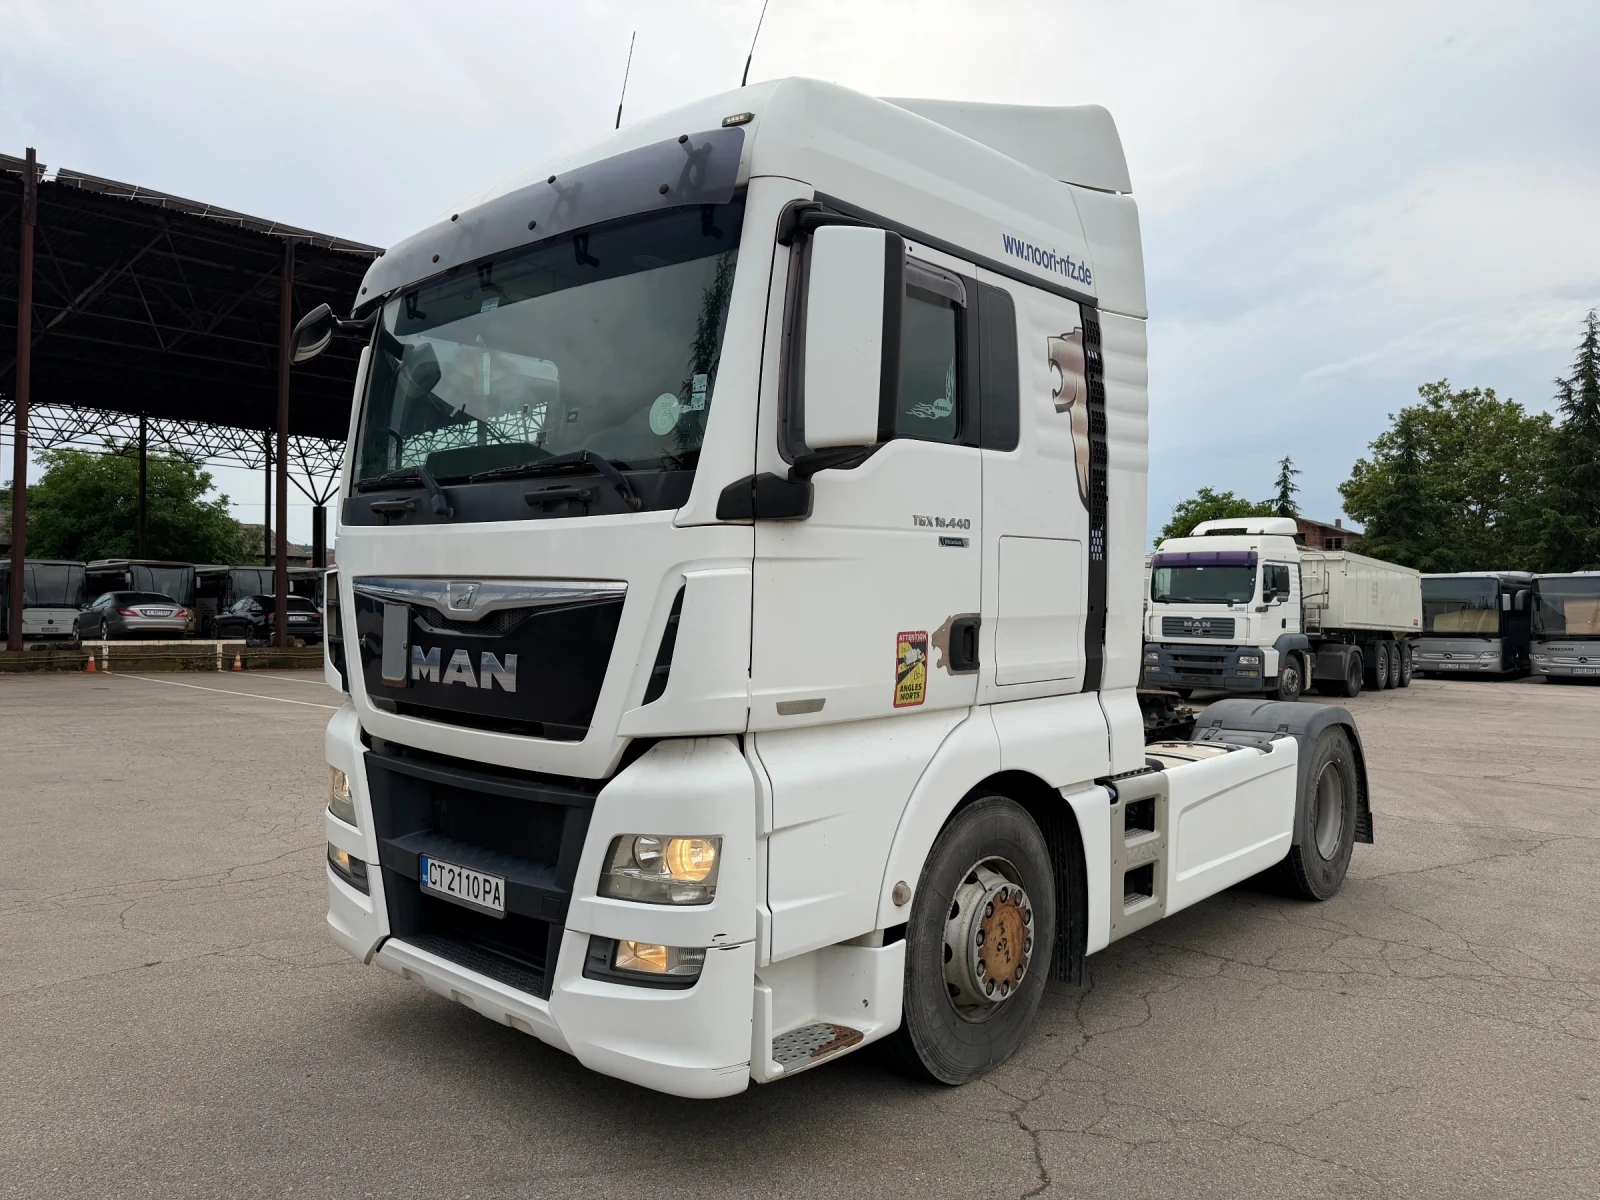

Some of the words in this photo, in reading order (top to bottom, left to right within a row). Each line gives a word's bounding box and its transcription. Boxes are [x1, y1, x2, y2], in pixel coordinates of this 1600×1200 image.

[1002, 233, 1092, 286] ww.noori-nfz.de
[898, 633, 927, 642] ATTENTION
[411, 645, 518, 692] MAN
[899, 683, 922, 693] ANGLES
[899, 691, 920, 701] MORTS
[1126, 841, 1159, 866] MAN
[998, 919, 1012, 965] MAN
